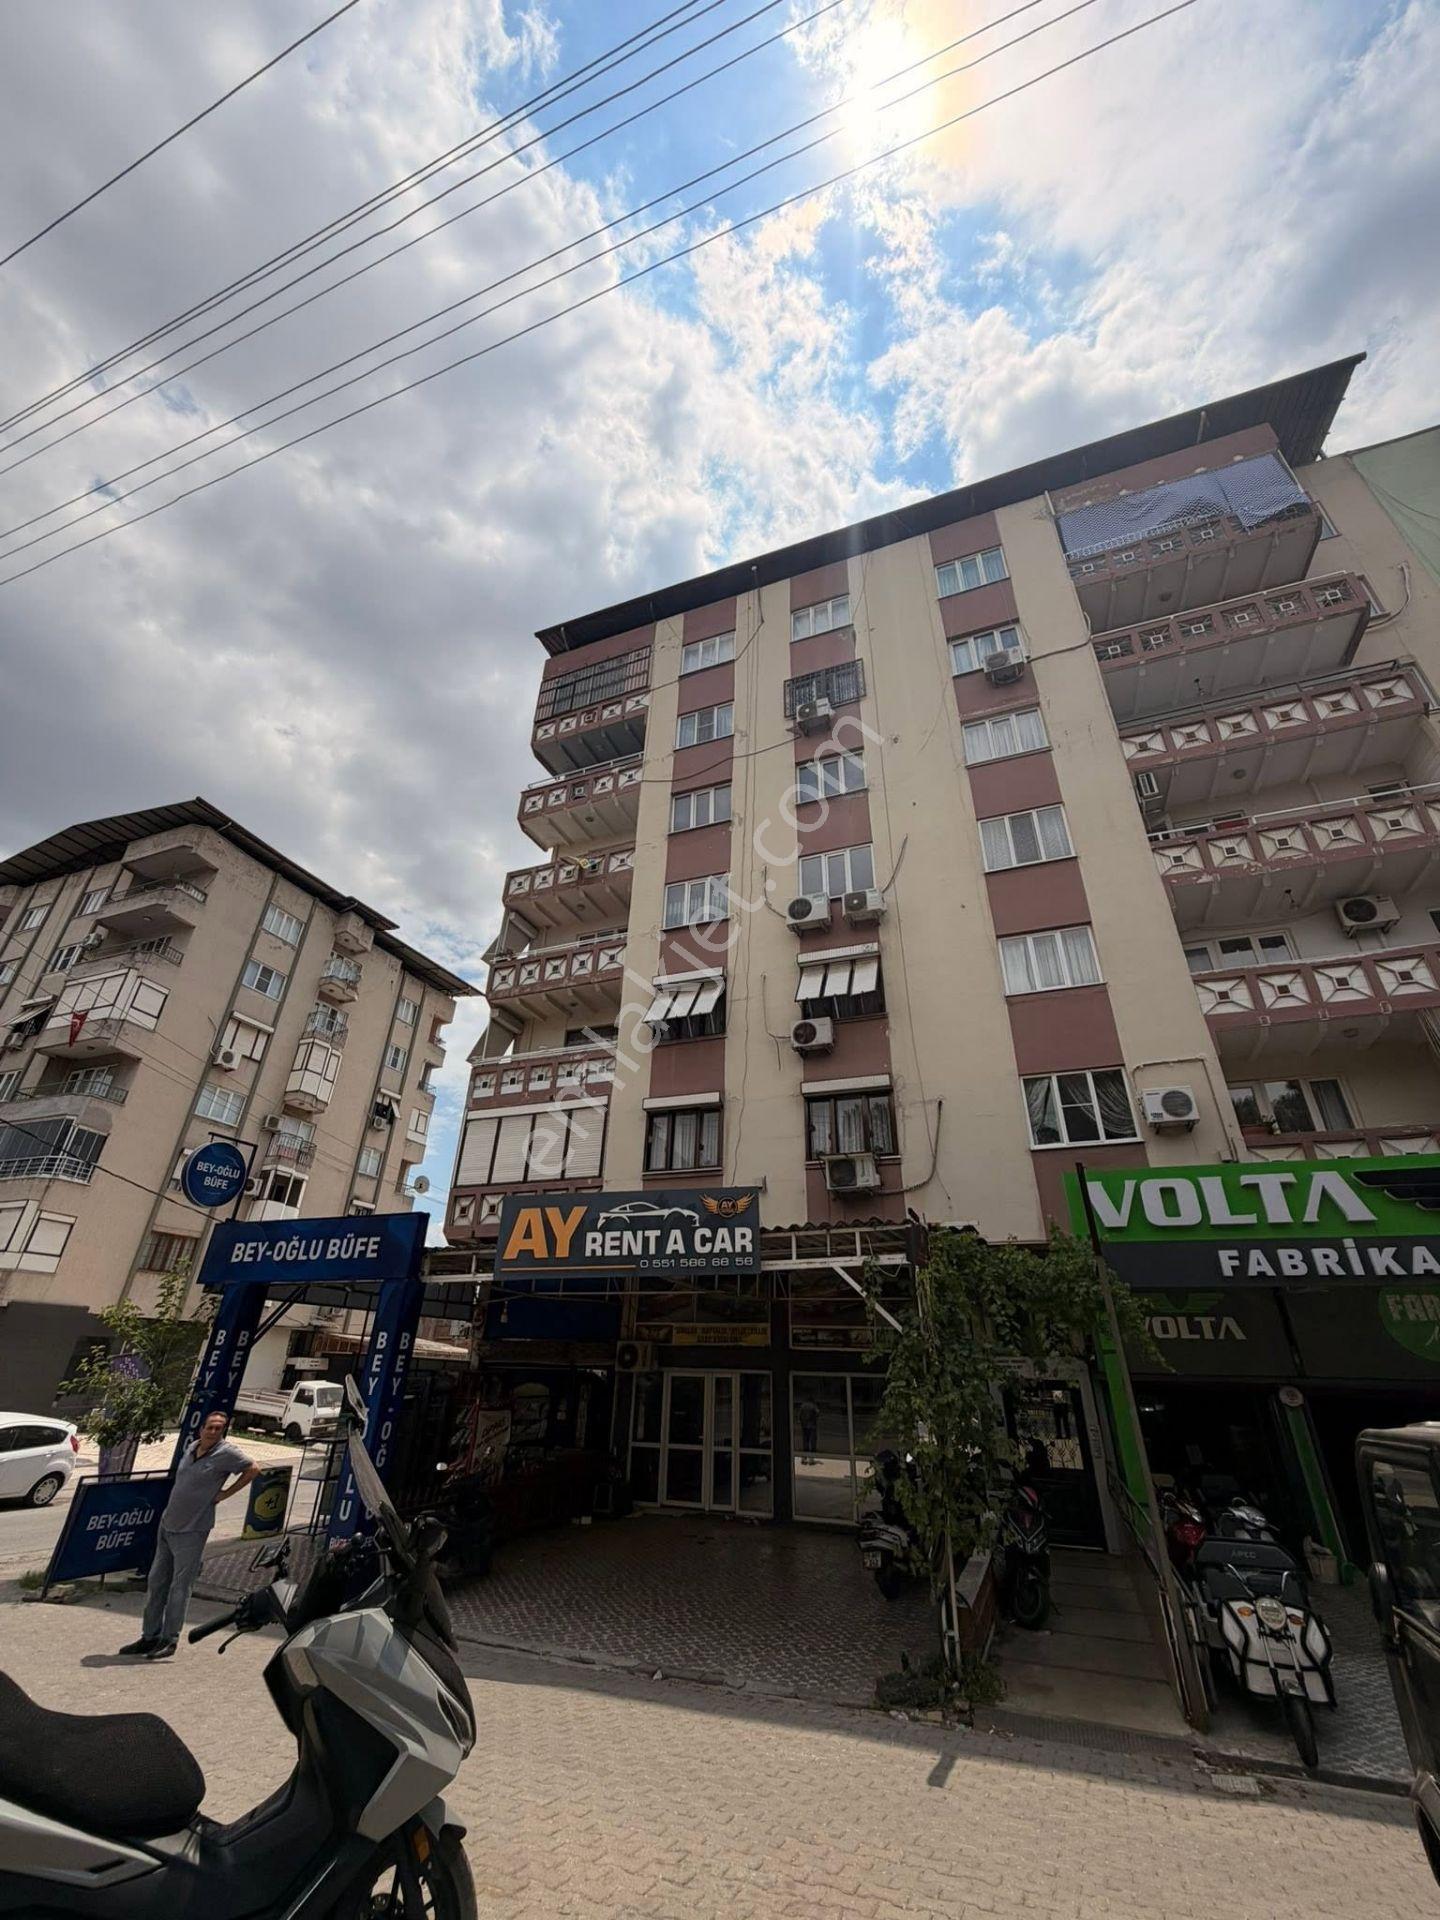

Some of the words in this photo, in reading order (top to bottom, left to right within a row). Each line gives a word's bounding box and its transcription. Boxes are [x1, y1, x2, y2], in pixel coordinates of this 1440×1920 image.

[196, 1161, 240, 1179] BEY-OĞLU
[203, 1176, 229, 1190] BÜFE
[1086, 1171, 1378, 1228] VOLTA
[502, 1206, 588, 1260] AY
[585, 1229, 660, 1257] RENT
[665, 1229, 685, 1255] A
[694, 1227, 753, 1254] CAR
[230, 1235, 323, 1263] BEY-OĞLU
[325, 1233, 380, 1259] BÜFE
[640, 1259, 649, 1268] 0
[652, 1258, 675, 1268] 551
[86, 1507, 155, 1531] BEY-OĞLU
[96, 1531, 135, 1551] BÜFE
